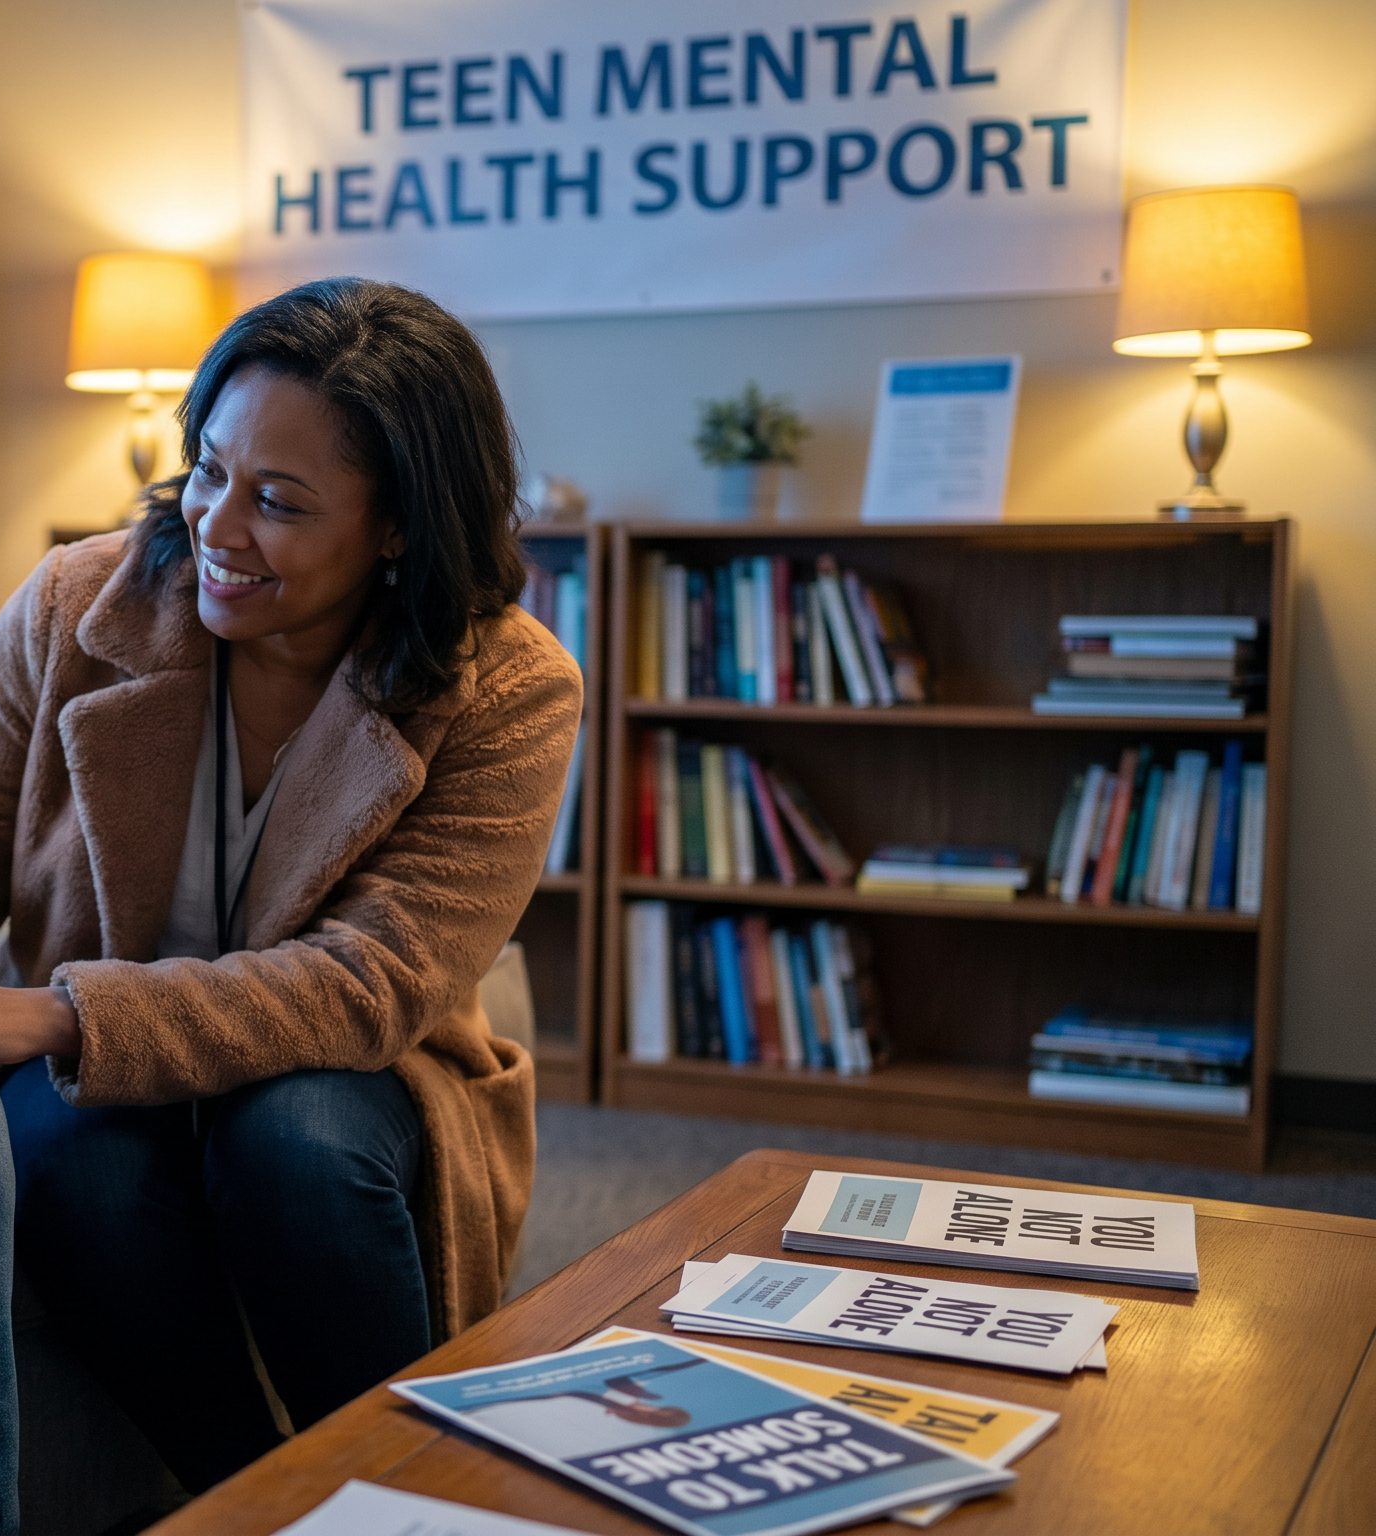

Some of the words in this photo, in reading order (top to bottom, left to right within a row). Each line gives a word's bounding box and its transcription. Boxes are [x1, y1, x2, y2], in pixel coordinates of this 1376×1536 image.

[344, 49, 563, 134] TEEN
[594, 14, 997, 116] MENTAL
[272, 147, 601, 236] HEALTH
[632, 114, 1088, 216] SUPPORT
[944, 1190, 1013, 1247] ALONE
[1018, 1208, 1083, 1245] NOT
[1090, 1216, 1155, 1252] YOU
[828, 1277, 929, 1337] ALONE
[922, 1296, 997, 1337] NOT
[987, 1309, 1074, 1348] YOU
[590, 1410, 852, 1486] SOMEONE
[740, 1438, 905, 1492] TALK
[666, 1473, 767, 1510] TO
